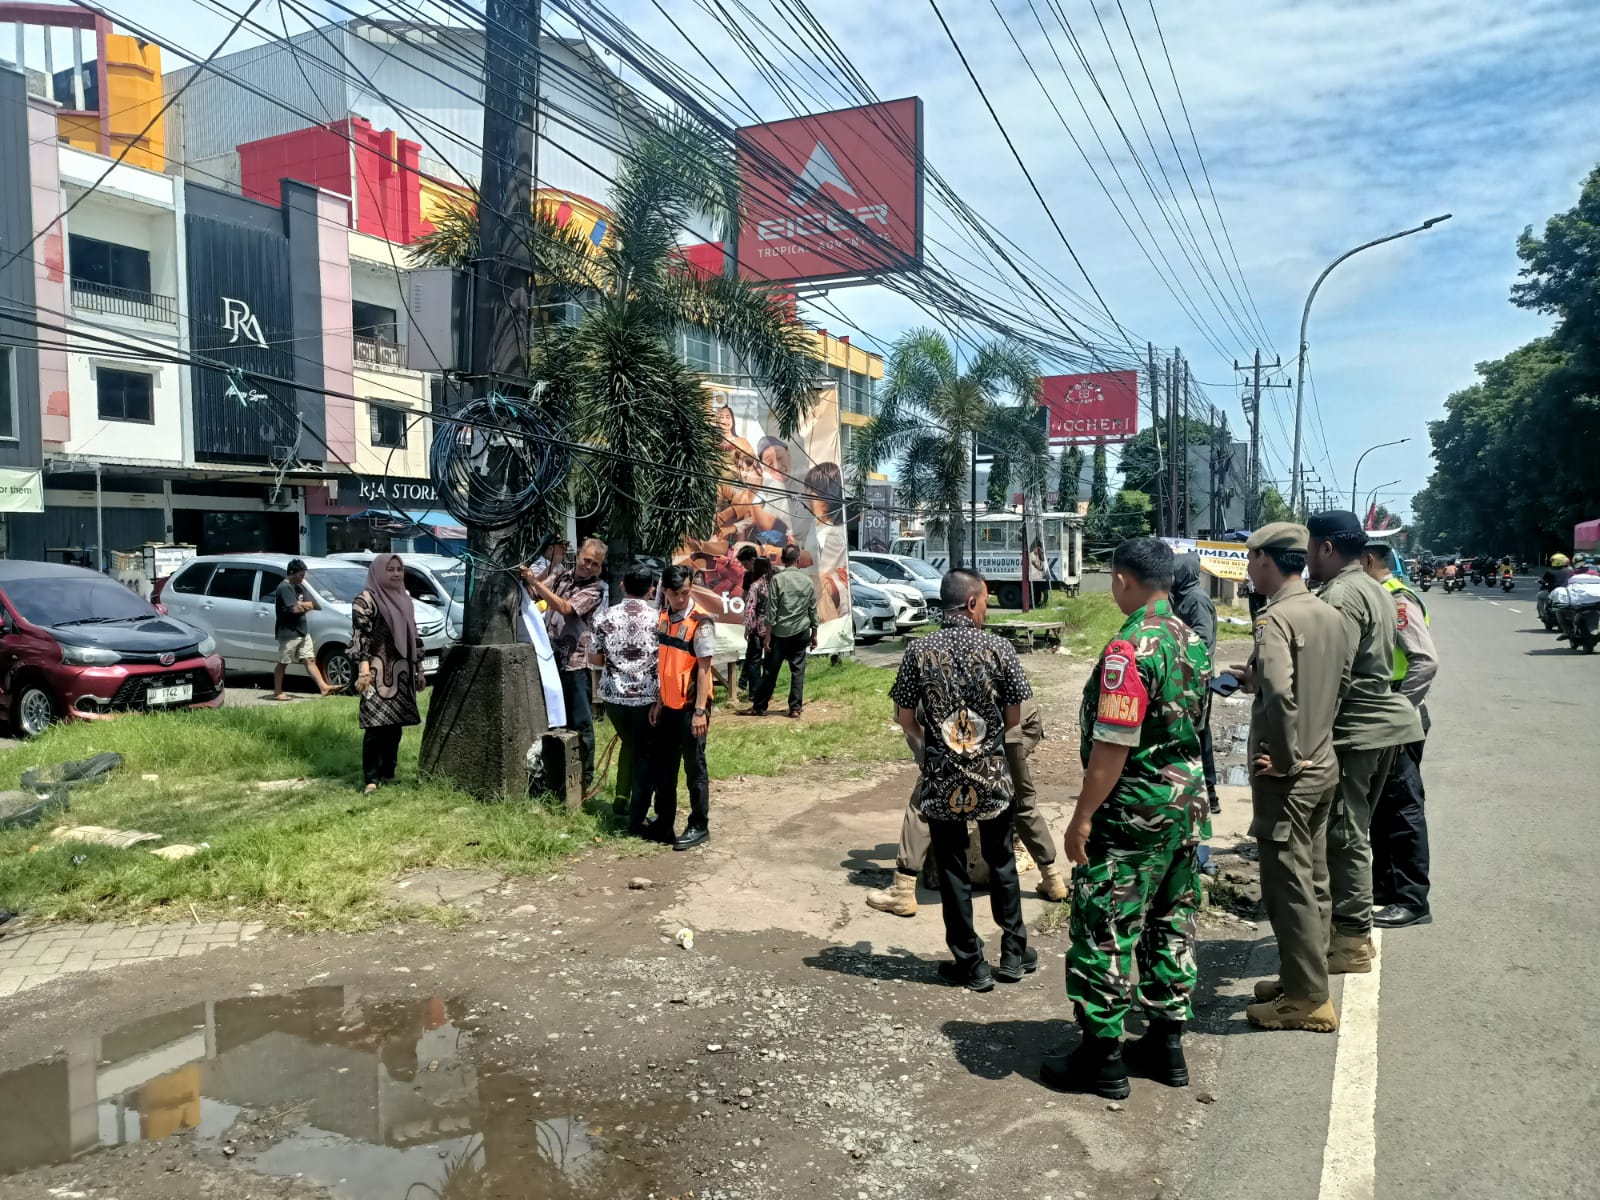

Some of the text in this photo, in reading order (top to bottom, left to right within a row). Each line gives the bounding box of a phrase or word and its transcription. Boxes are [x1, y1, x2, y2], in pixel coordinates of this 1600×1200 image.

[757, 203, 888, 241] EIGER
[757, 232, 891, 258] TROPICAL ADVENTE
[1051, 418, 1129, 431] UCCHERI
[10, 485, 32, 495] them
[359, 481, 438, 501] RJA STORE
[978, 558, 1023, 566] PERHUBUNG
